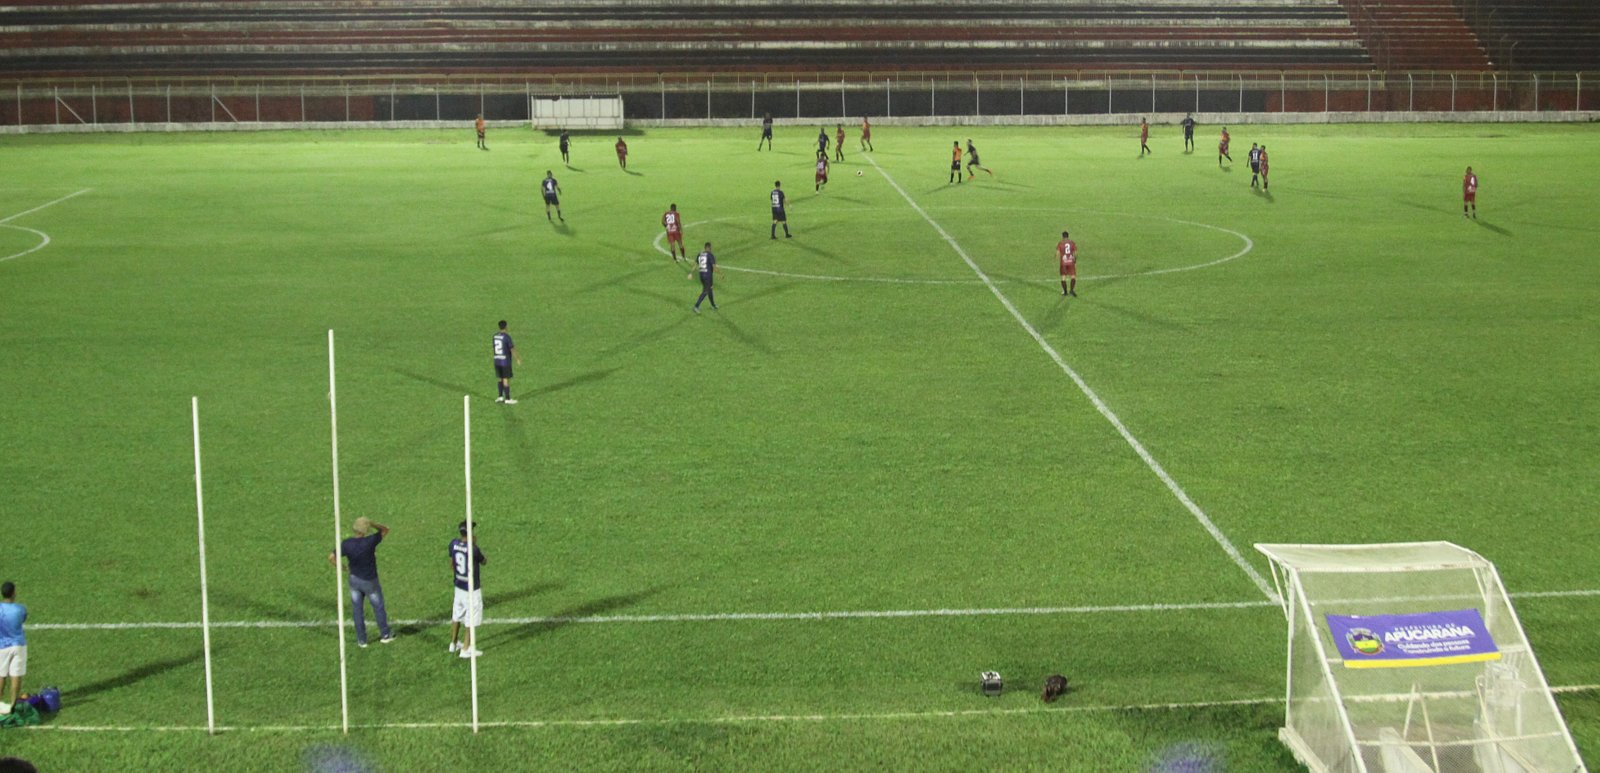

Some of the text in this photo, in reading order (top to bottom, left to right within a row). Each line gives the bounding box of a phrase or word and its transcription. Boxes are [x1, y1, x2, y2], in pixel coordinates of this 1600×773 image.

[1064, 243, 1071, 255] 2
[494, 339, 503, 355] 2
[455, 552, 466, 575] 9
[1384, 625, 1475, 642] APUCARANA
